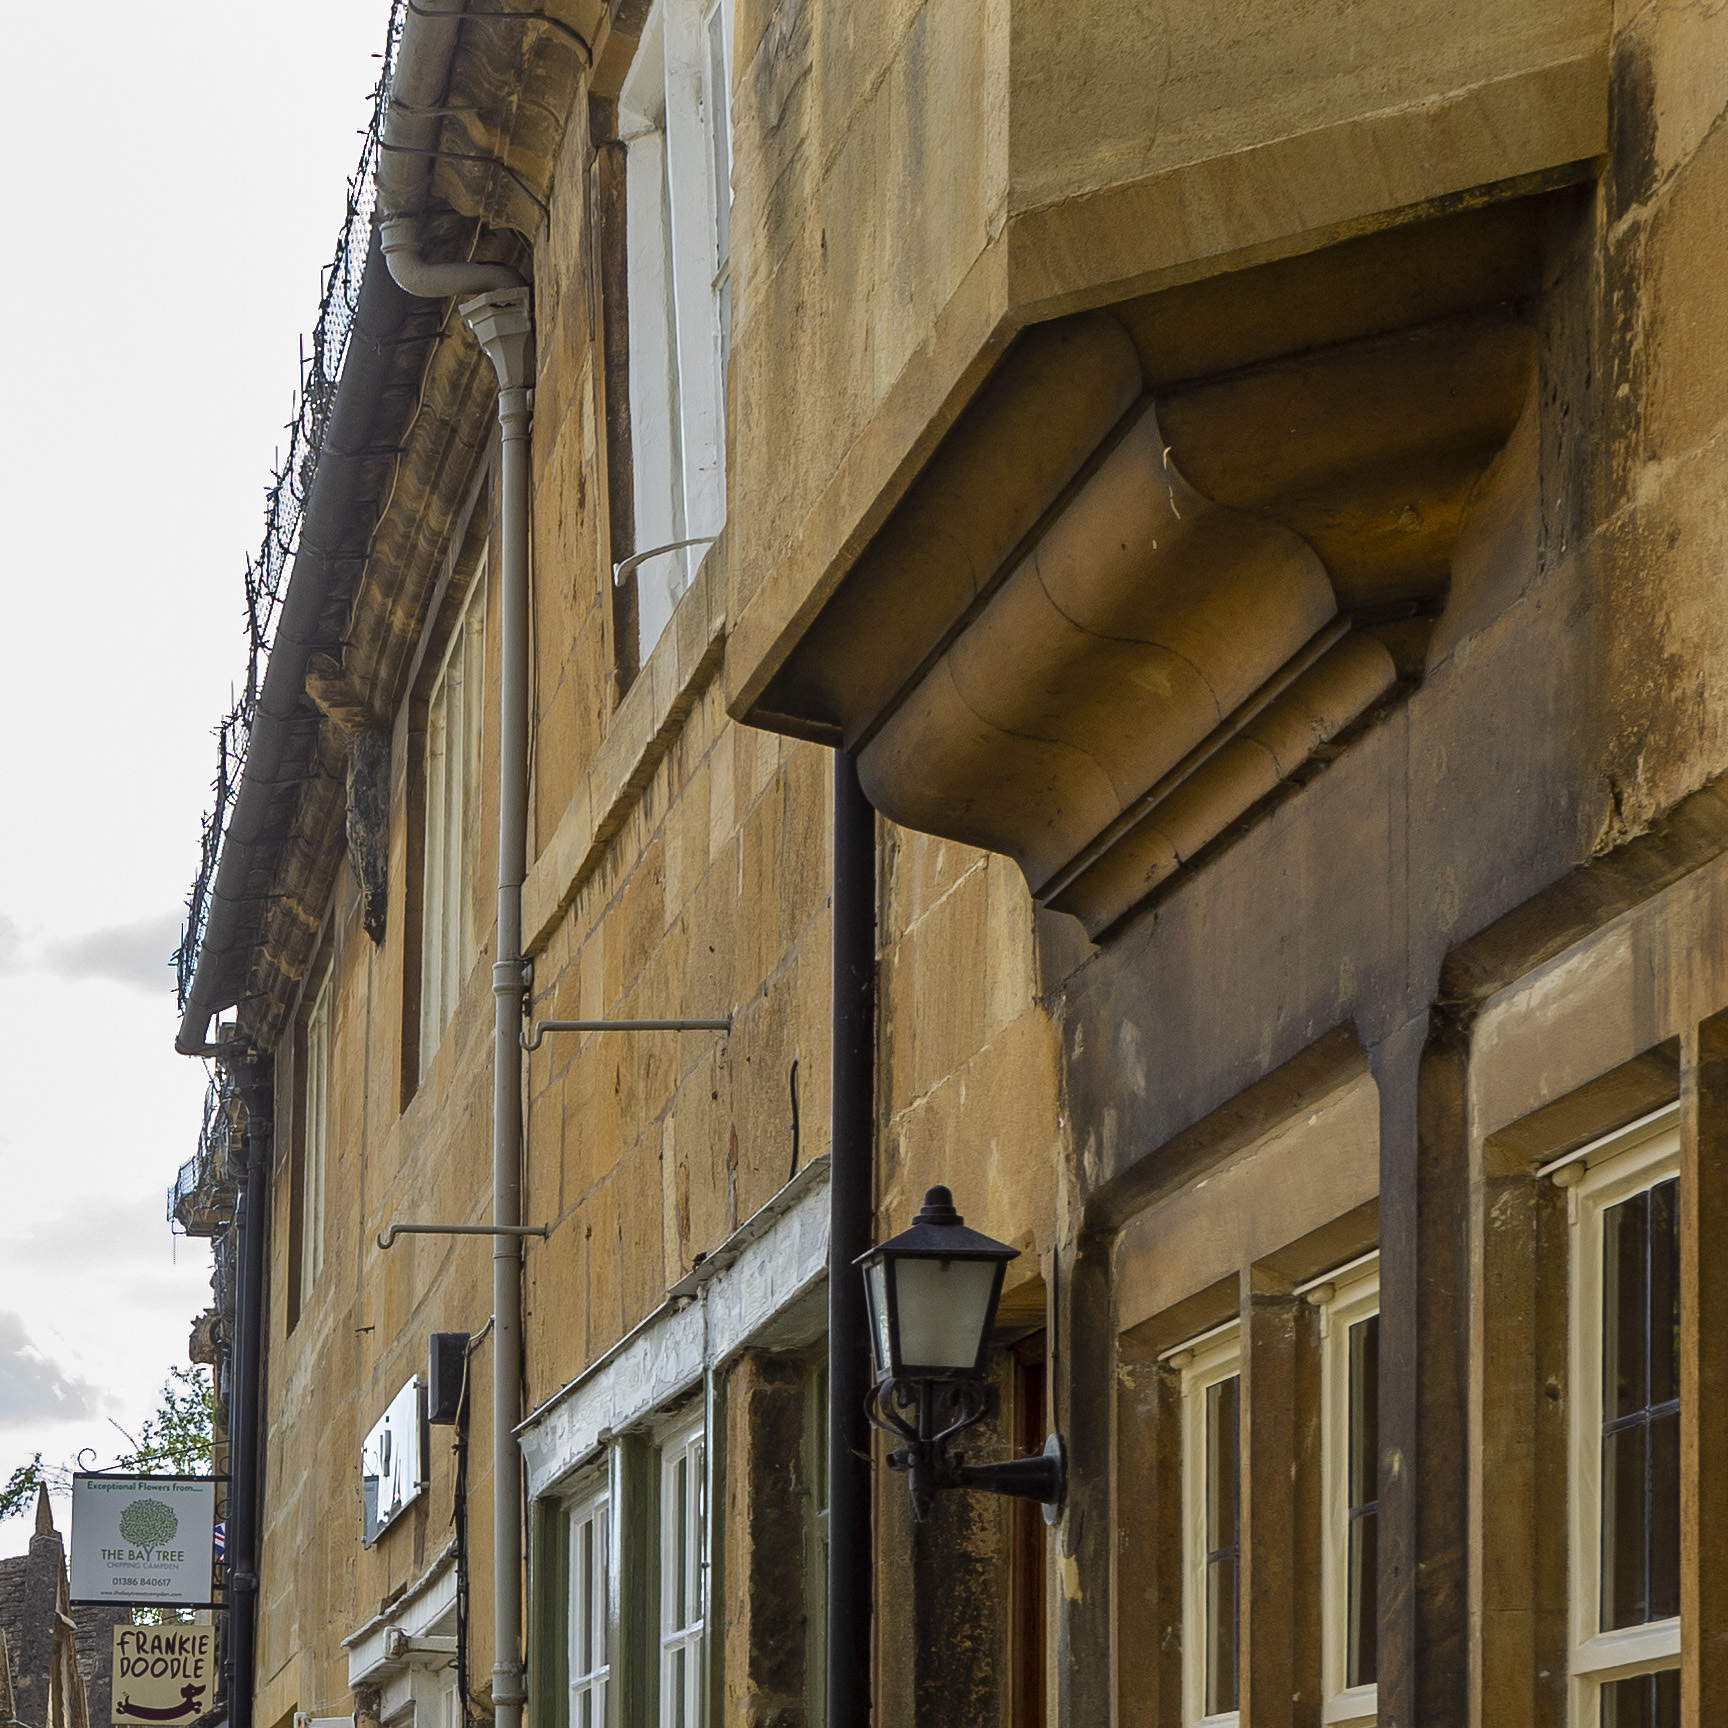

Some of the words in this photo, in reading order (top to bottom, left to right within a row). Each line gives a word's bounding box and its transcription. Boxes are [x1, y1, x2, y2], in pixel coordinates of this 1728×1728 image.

[87, 1481, 136, 1492] Exceptional
[138, 1482, 170, 1491] Flowers
[101, 1549, 124, 1560] THE
[128, 1546, 155, 1561] BAY
[156, 1550, 184, 1561] TREE
[143, 1562, 179, 1570] CAMPDEN
[112, 1577, 138, 1586] 01386
[140, 1578, 171, 1586] 840617
[116, 1631, 209, 1657] FRANKIE
[120, 1656, 204, 1679] DOODLE
